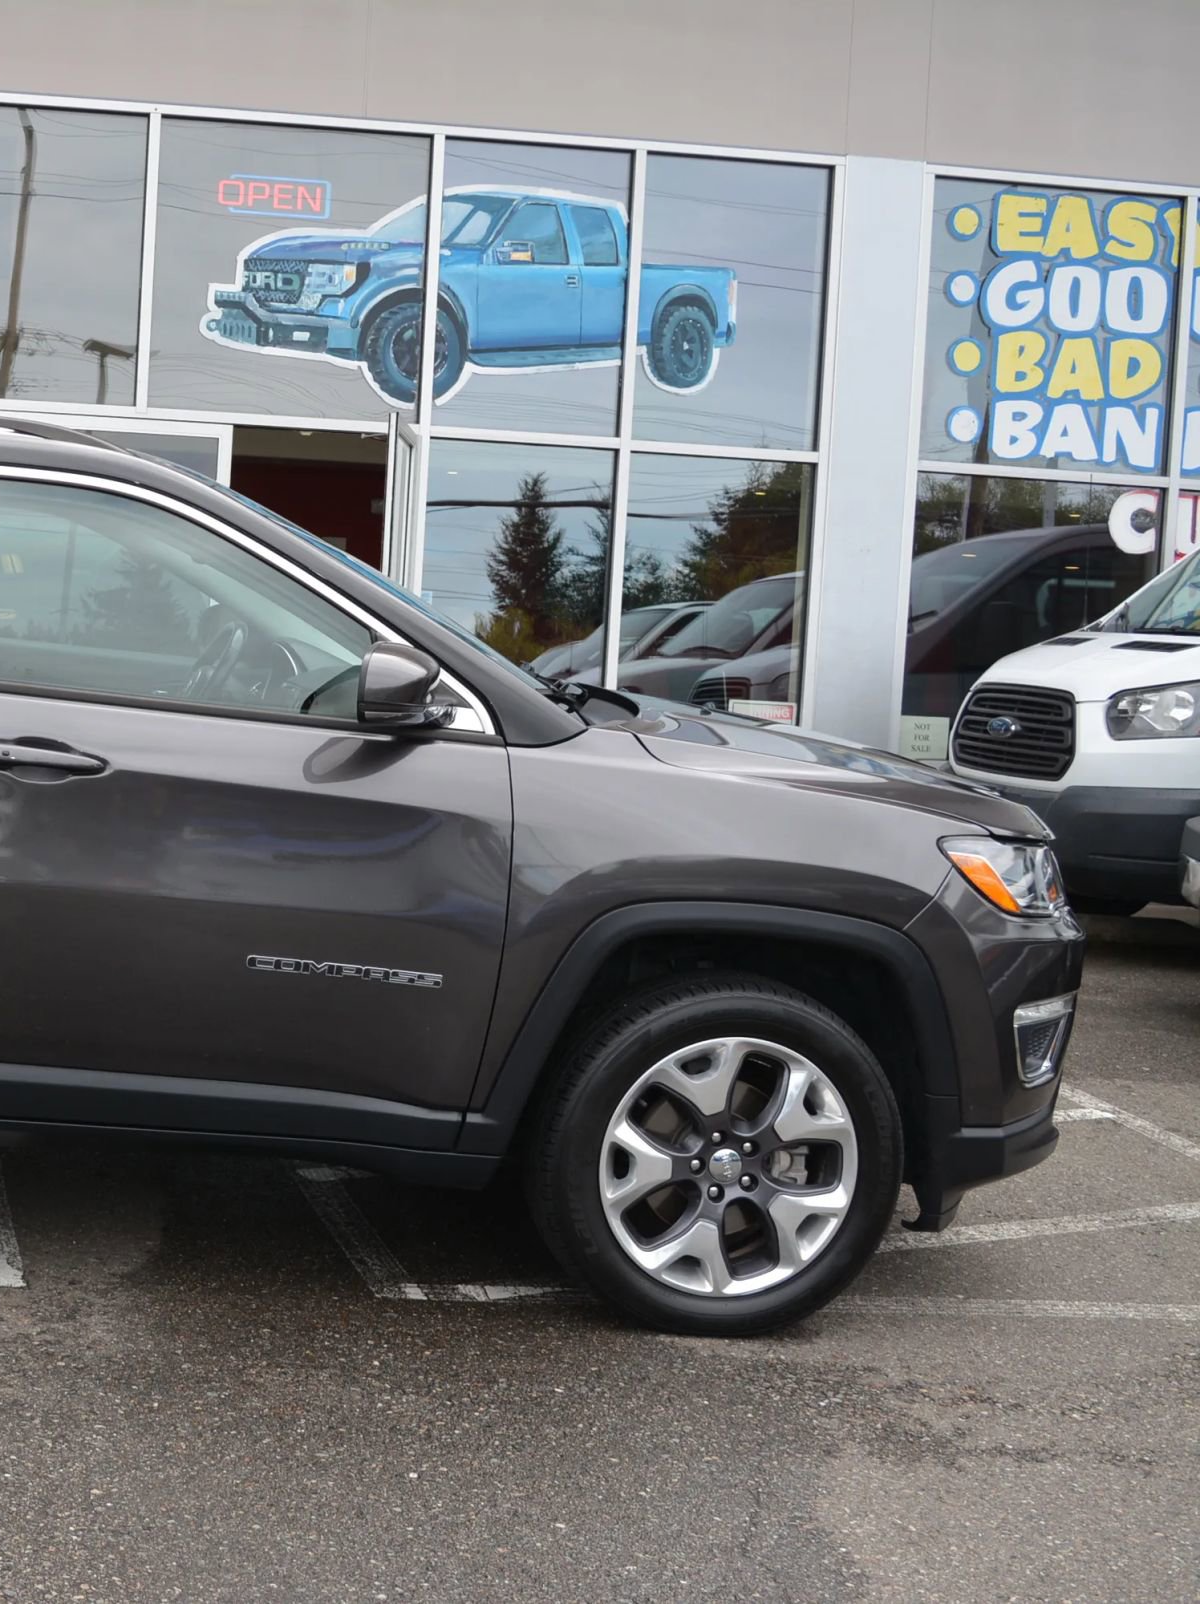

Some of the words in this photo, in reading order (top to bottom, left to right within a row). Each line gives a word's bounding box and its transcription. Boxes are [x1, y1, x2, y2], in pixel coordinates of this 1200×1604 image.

[218, 179, 322, 213] OPEN
[985, 259, 1200, 335] GOO
[994, 330, 1164, 401] BAD
[913, 722, 931, 731] NOT
[913, 734, 930, 742] FOR
[911, 744, 931, 753] SALE
[246, 954, 444, 989] COMPASS
